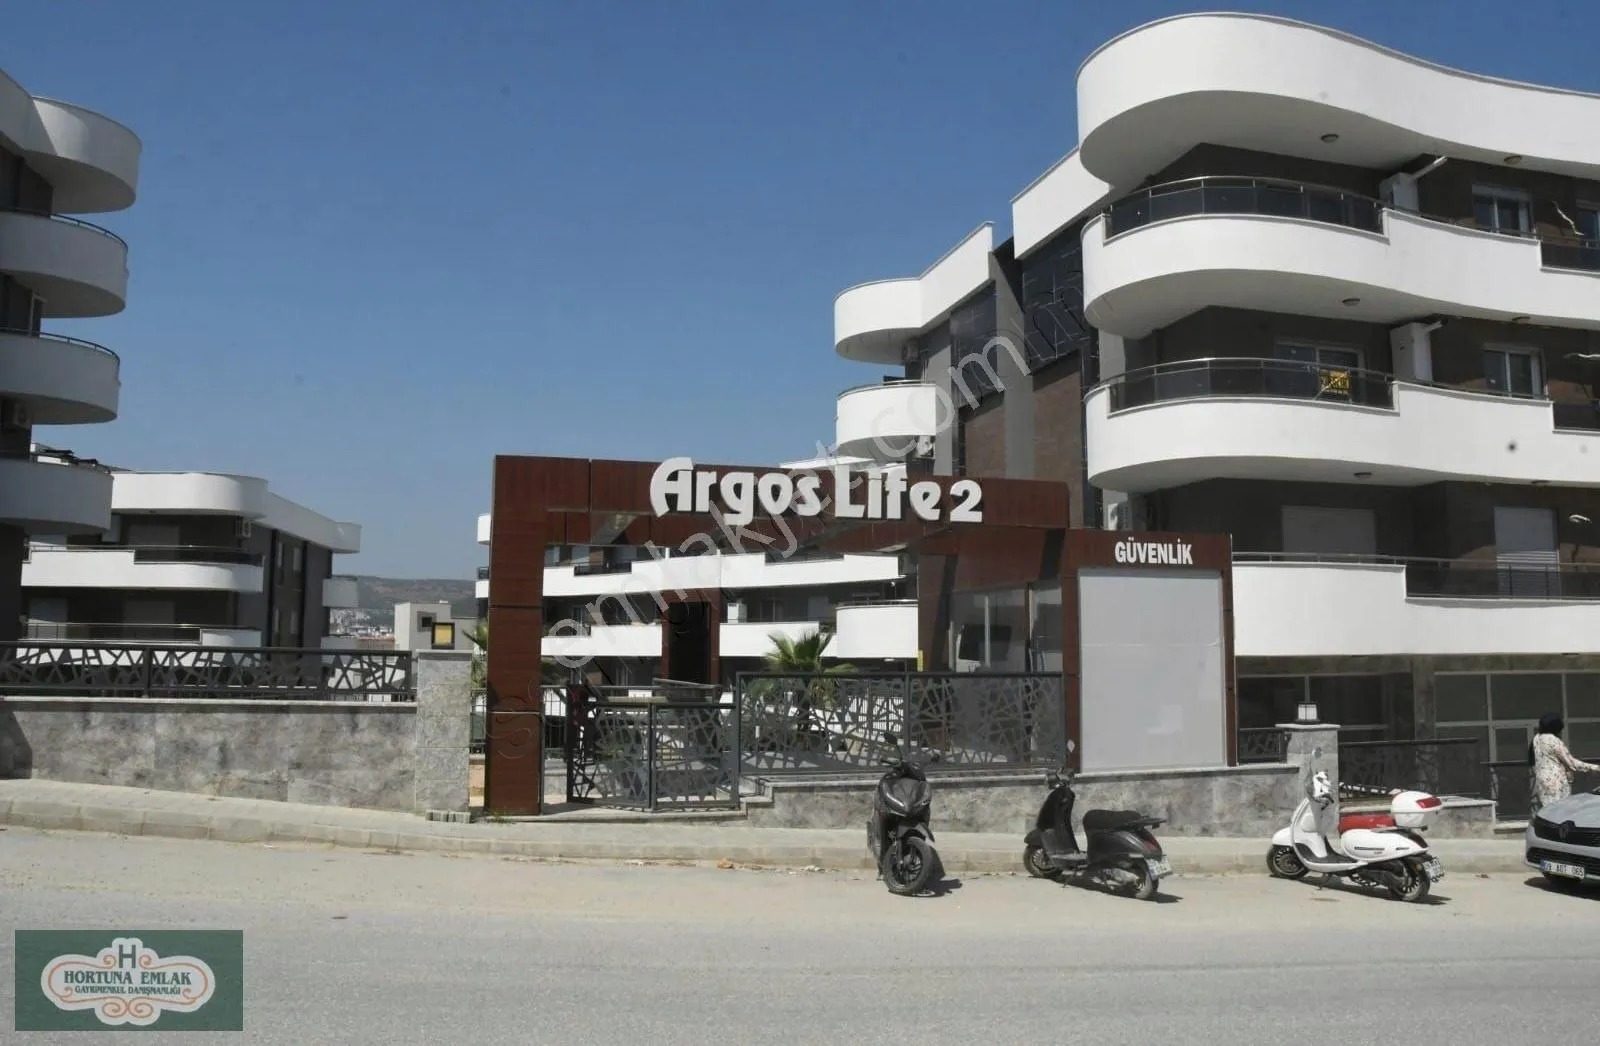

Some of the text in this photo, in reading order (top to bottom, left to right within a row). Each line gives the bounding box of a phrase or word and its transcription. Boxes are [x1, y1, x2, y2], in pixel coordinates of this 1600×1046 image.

[650, 457, 984, 526] Argos Life 2
[1114, 536, 1193, 565] GÜVENLİK
